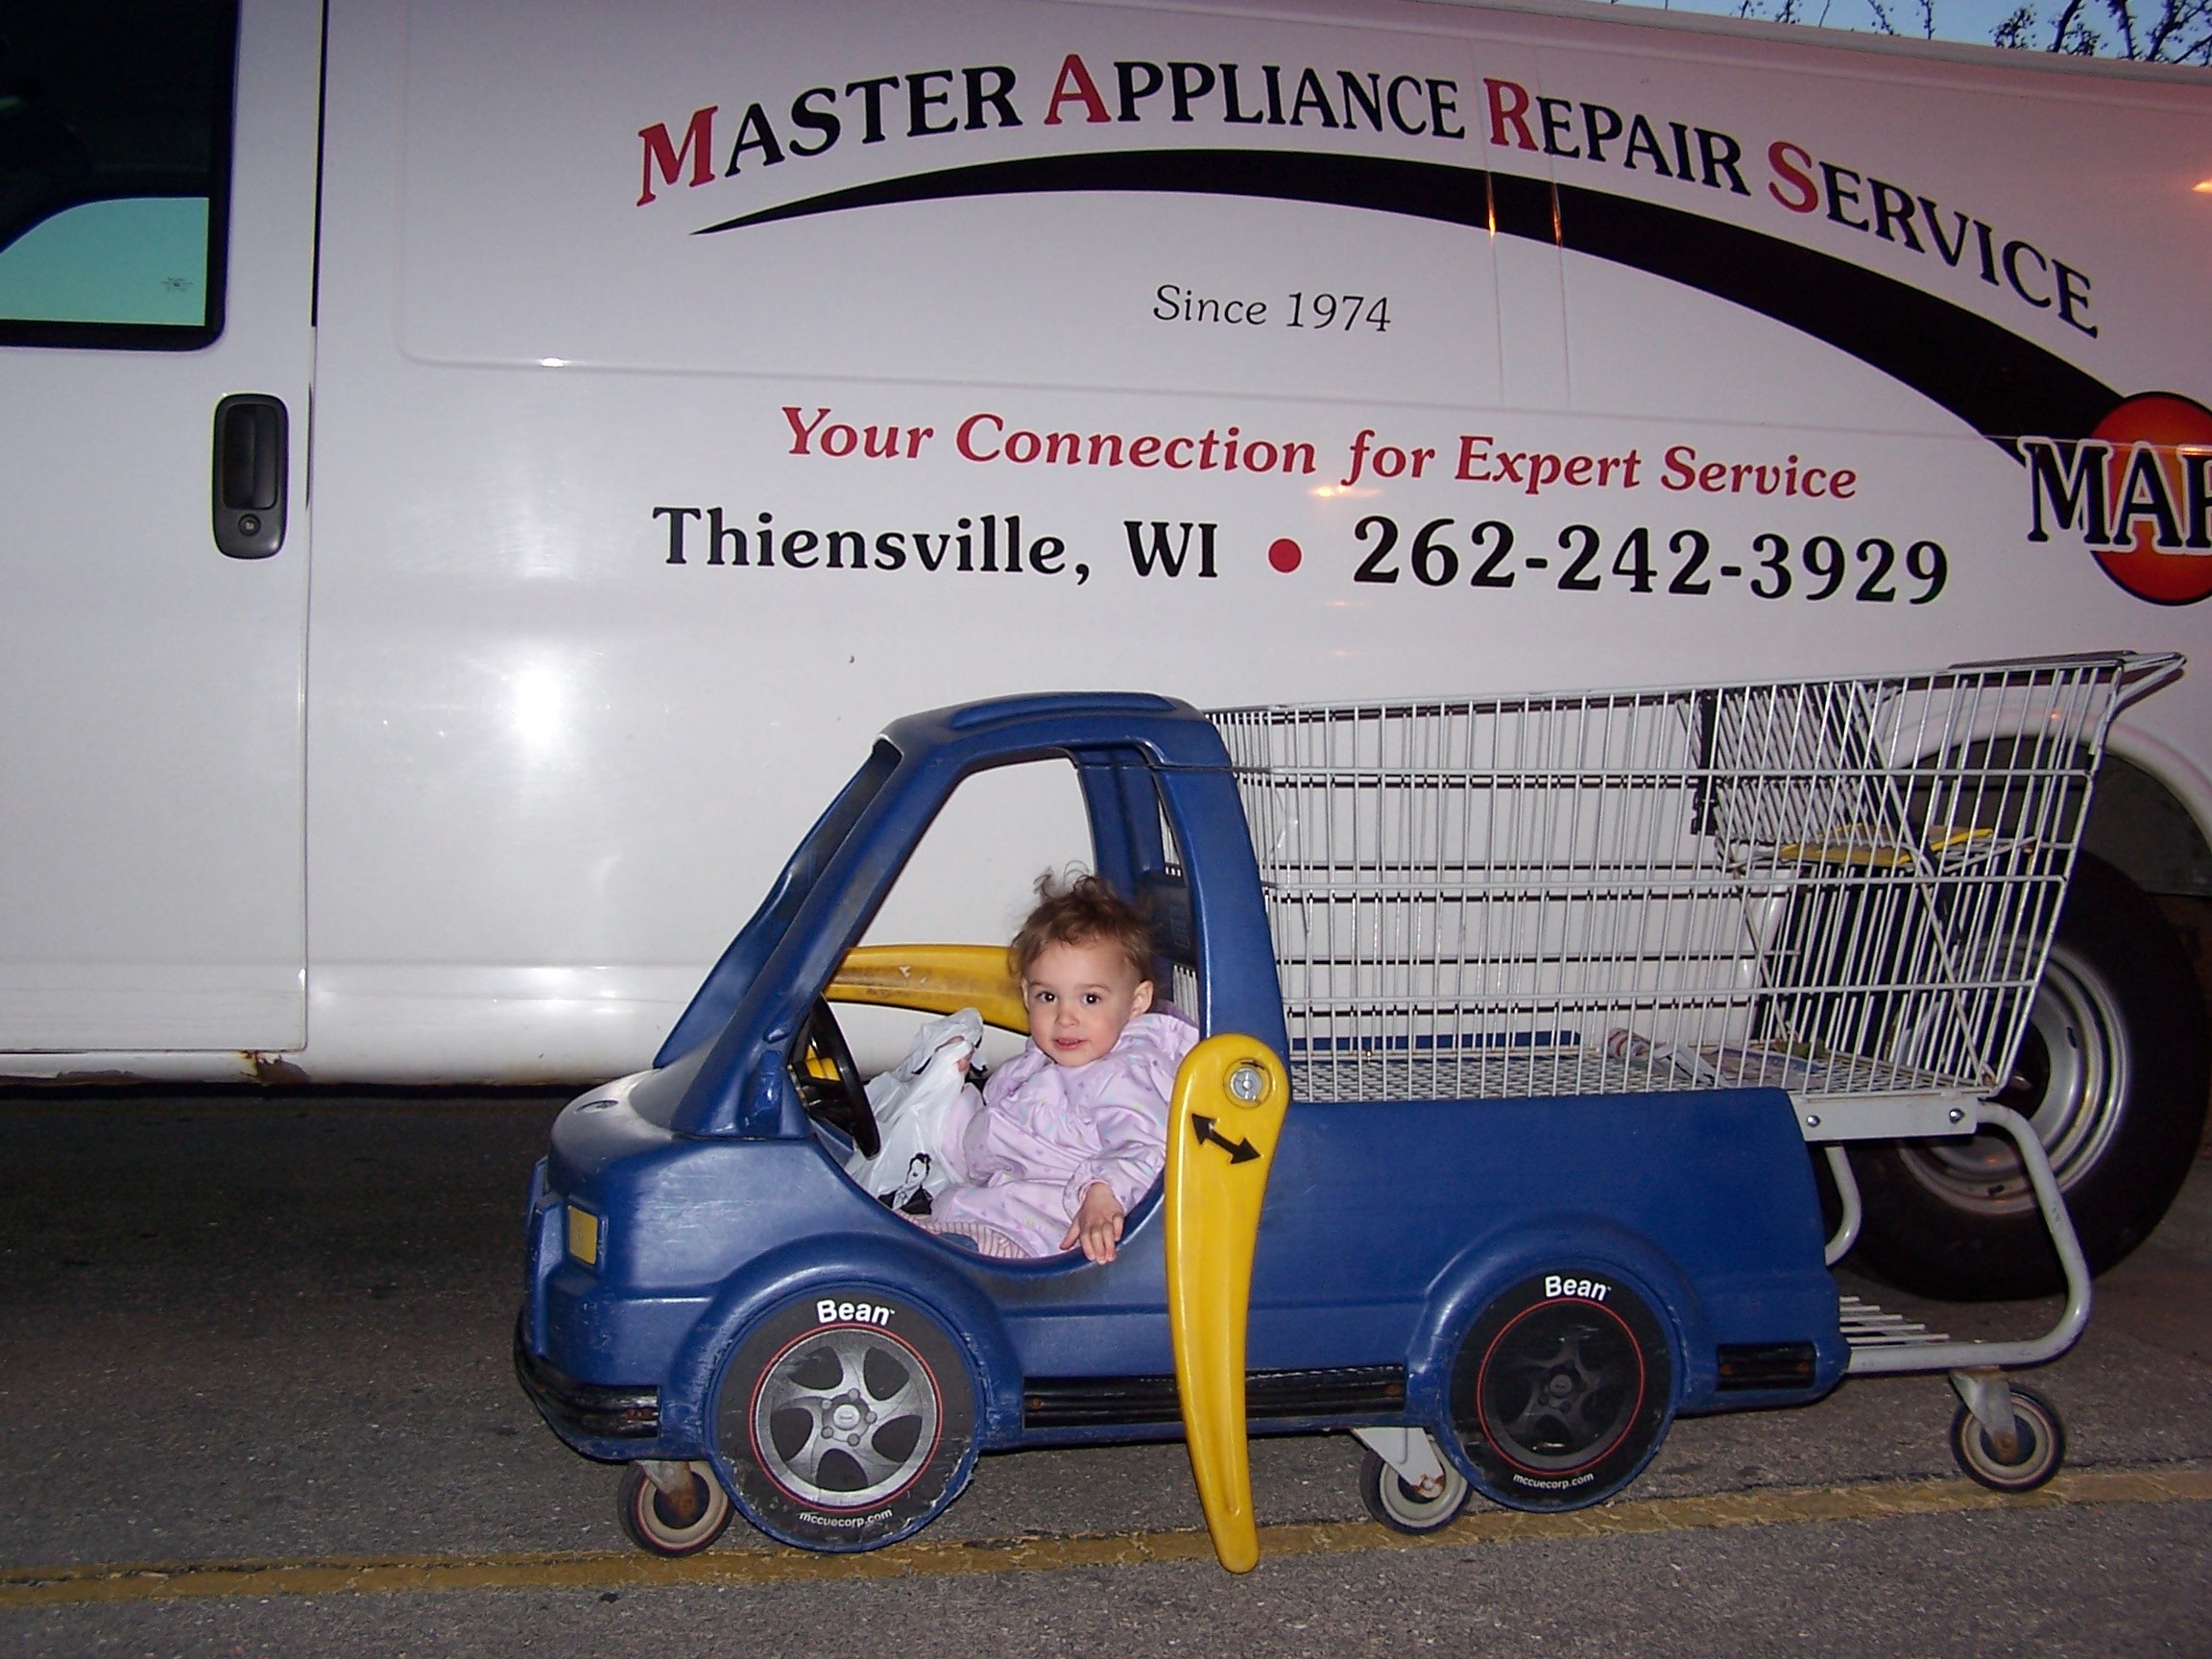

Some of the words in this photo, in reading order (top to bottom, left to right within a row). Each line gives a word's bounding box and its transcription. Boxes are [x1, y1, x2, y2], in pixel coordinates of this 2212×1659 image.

[635, 64, 1023, 207] MASTER
[1044, 53, 1467, 140] APPLIANCE
[1482, 76, 1752, 198] REPAIR
[1767, 139, 2100, 339] SERVICE
[1152, 283, 1268, 327] Since
[1285, 291, 1392, 334] 1974
[781, 405, 935, 460] Your
[955, 412, 1316, 475] Connection
[1340, 428, 1436, 489] for
[1454, 434, 1643, 496] Expert
[1659, 444, 1858, 500] Service
[651, 505, 1092, 586] Thiensville,
[1122, 519, 1218, 579] WI
[1352, 514, 1950, 607] 262-242-3929
[1544, 1274, 1612, 1302] Bean
[815, 1298, 895, 1327] Bean
[1512, 1472, 1595, 1491] mccuecorp.com
[798, 1507, 894, 1528] mccuecorp.com
